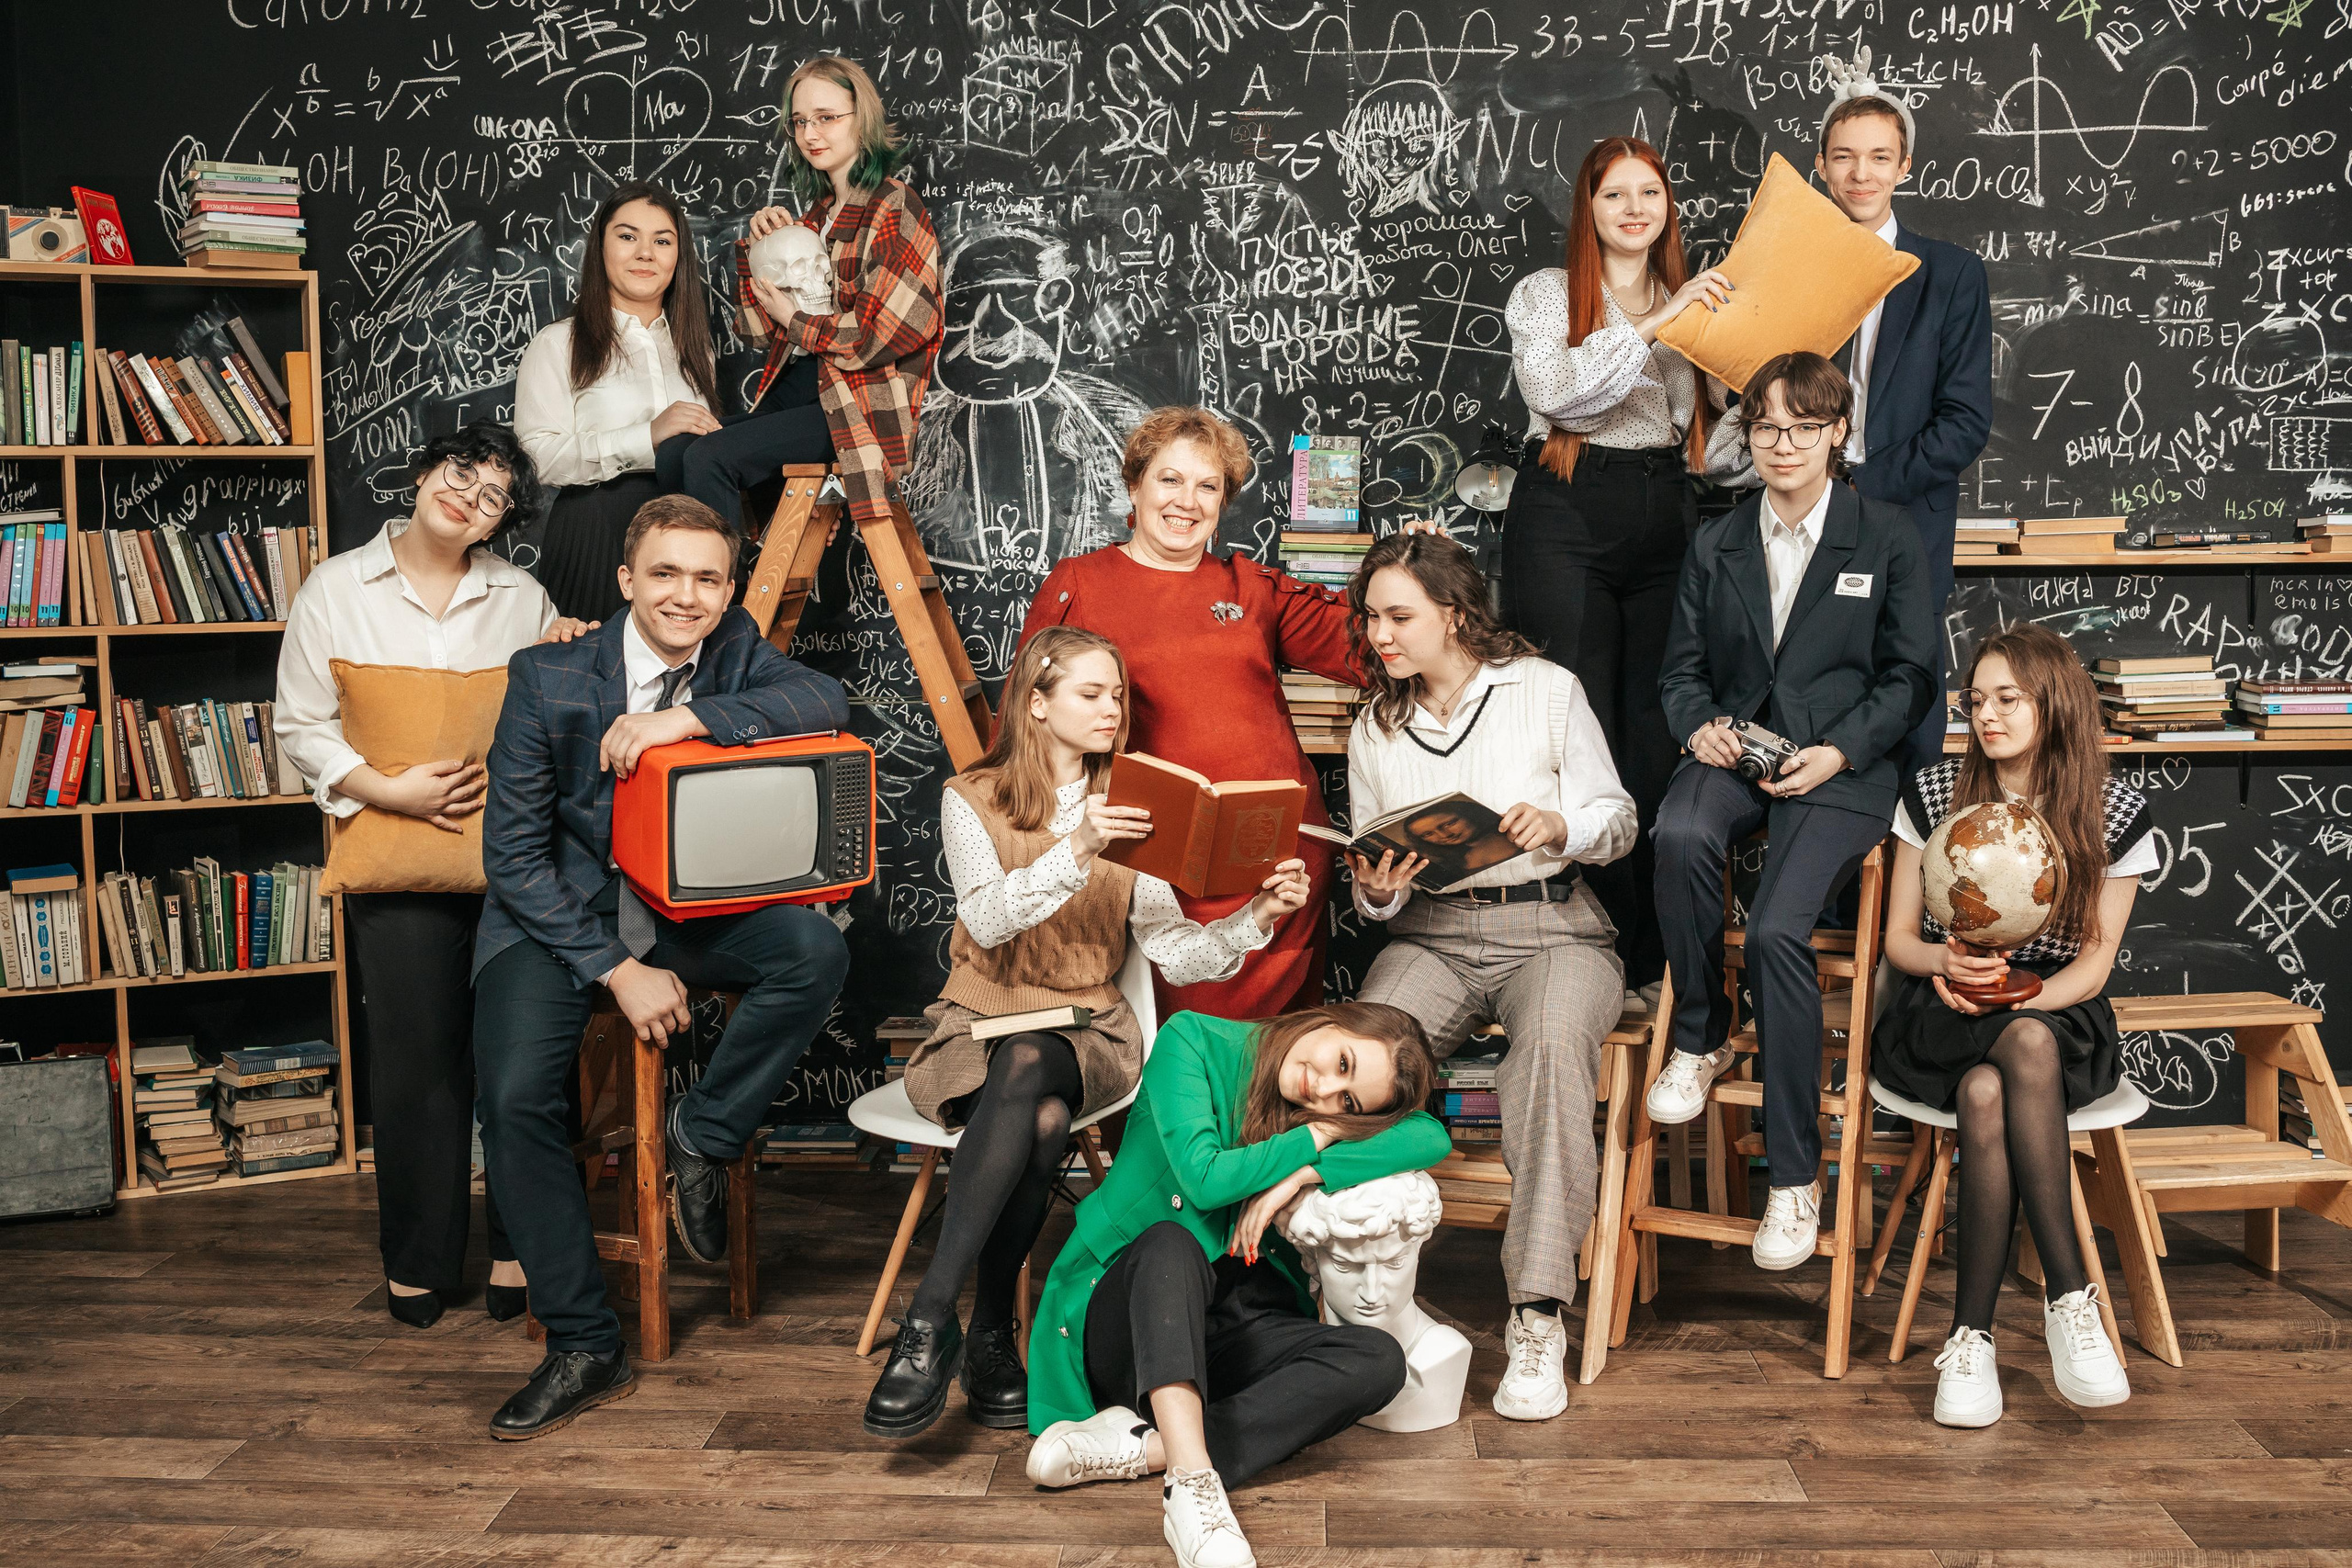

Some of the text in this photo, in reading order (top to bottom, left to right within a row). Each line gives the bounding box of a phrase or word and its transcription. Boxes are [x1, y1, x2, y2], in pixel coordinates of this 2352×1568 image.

[1369, 213, 1507, 246] хорошая
[1297, 450, 1308, 520] ЛИТЕРАТУРА
[1346, 510, 1357, 521] 11
[268, 547, 277, 587] ВОДОСНАБЖЕНИЕ
[4, 936, 17, 977] ЖЕНСКАЯ
